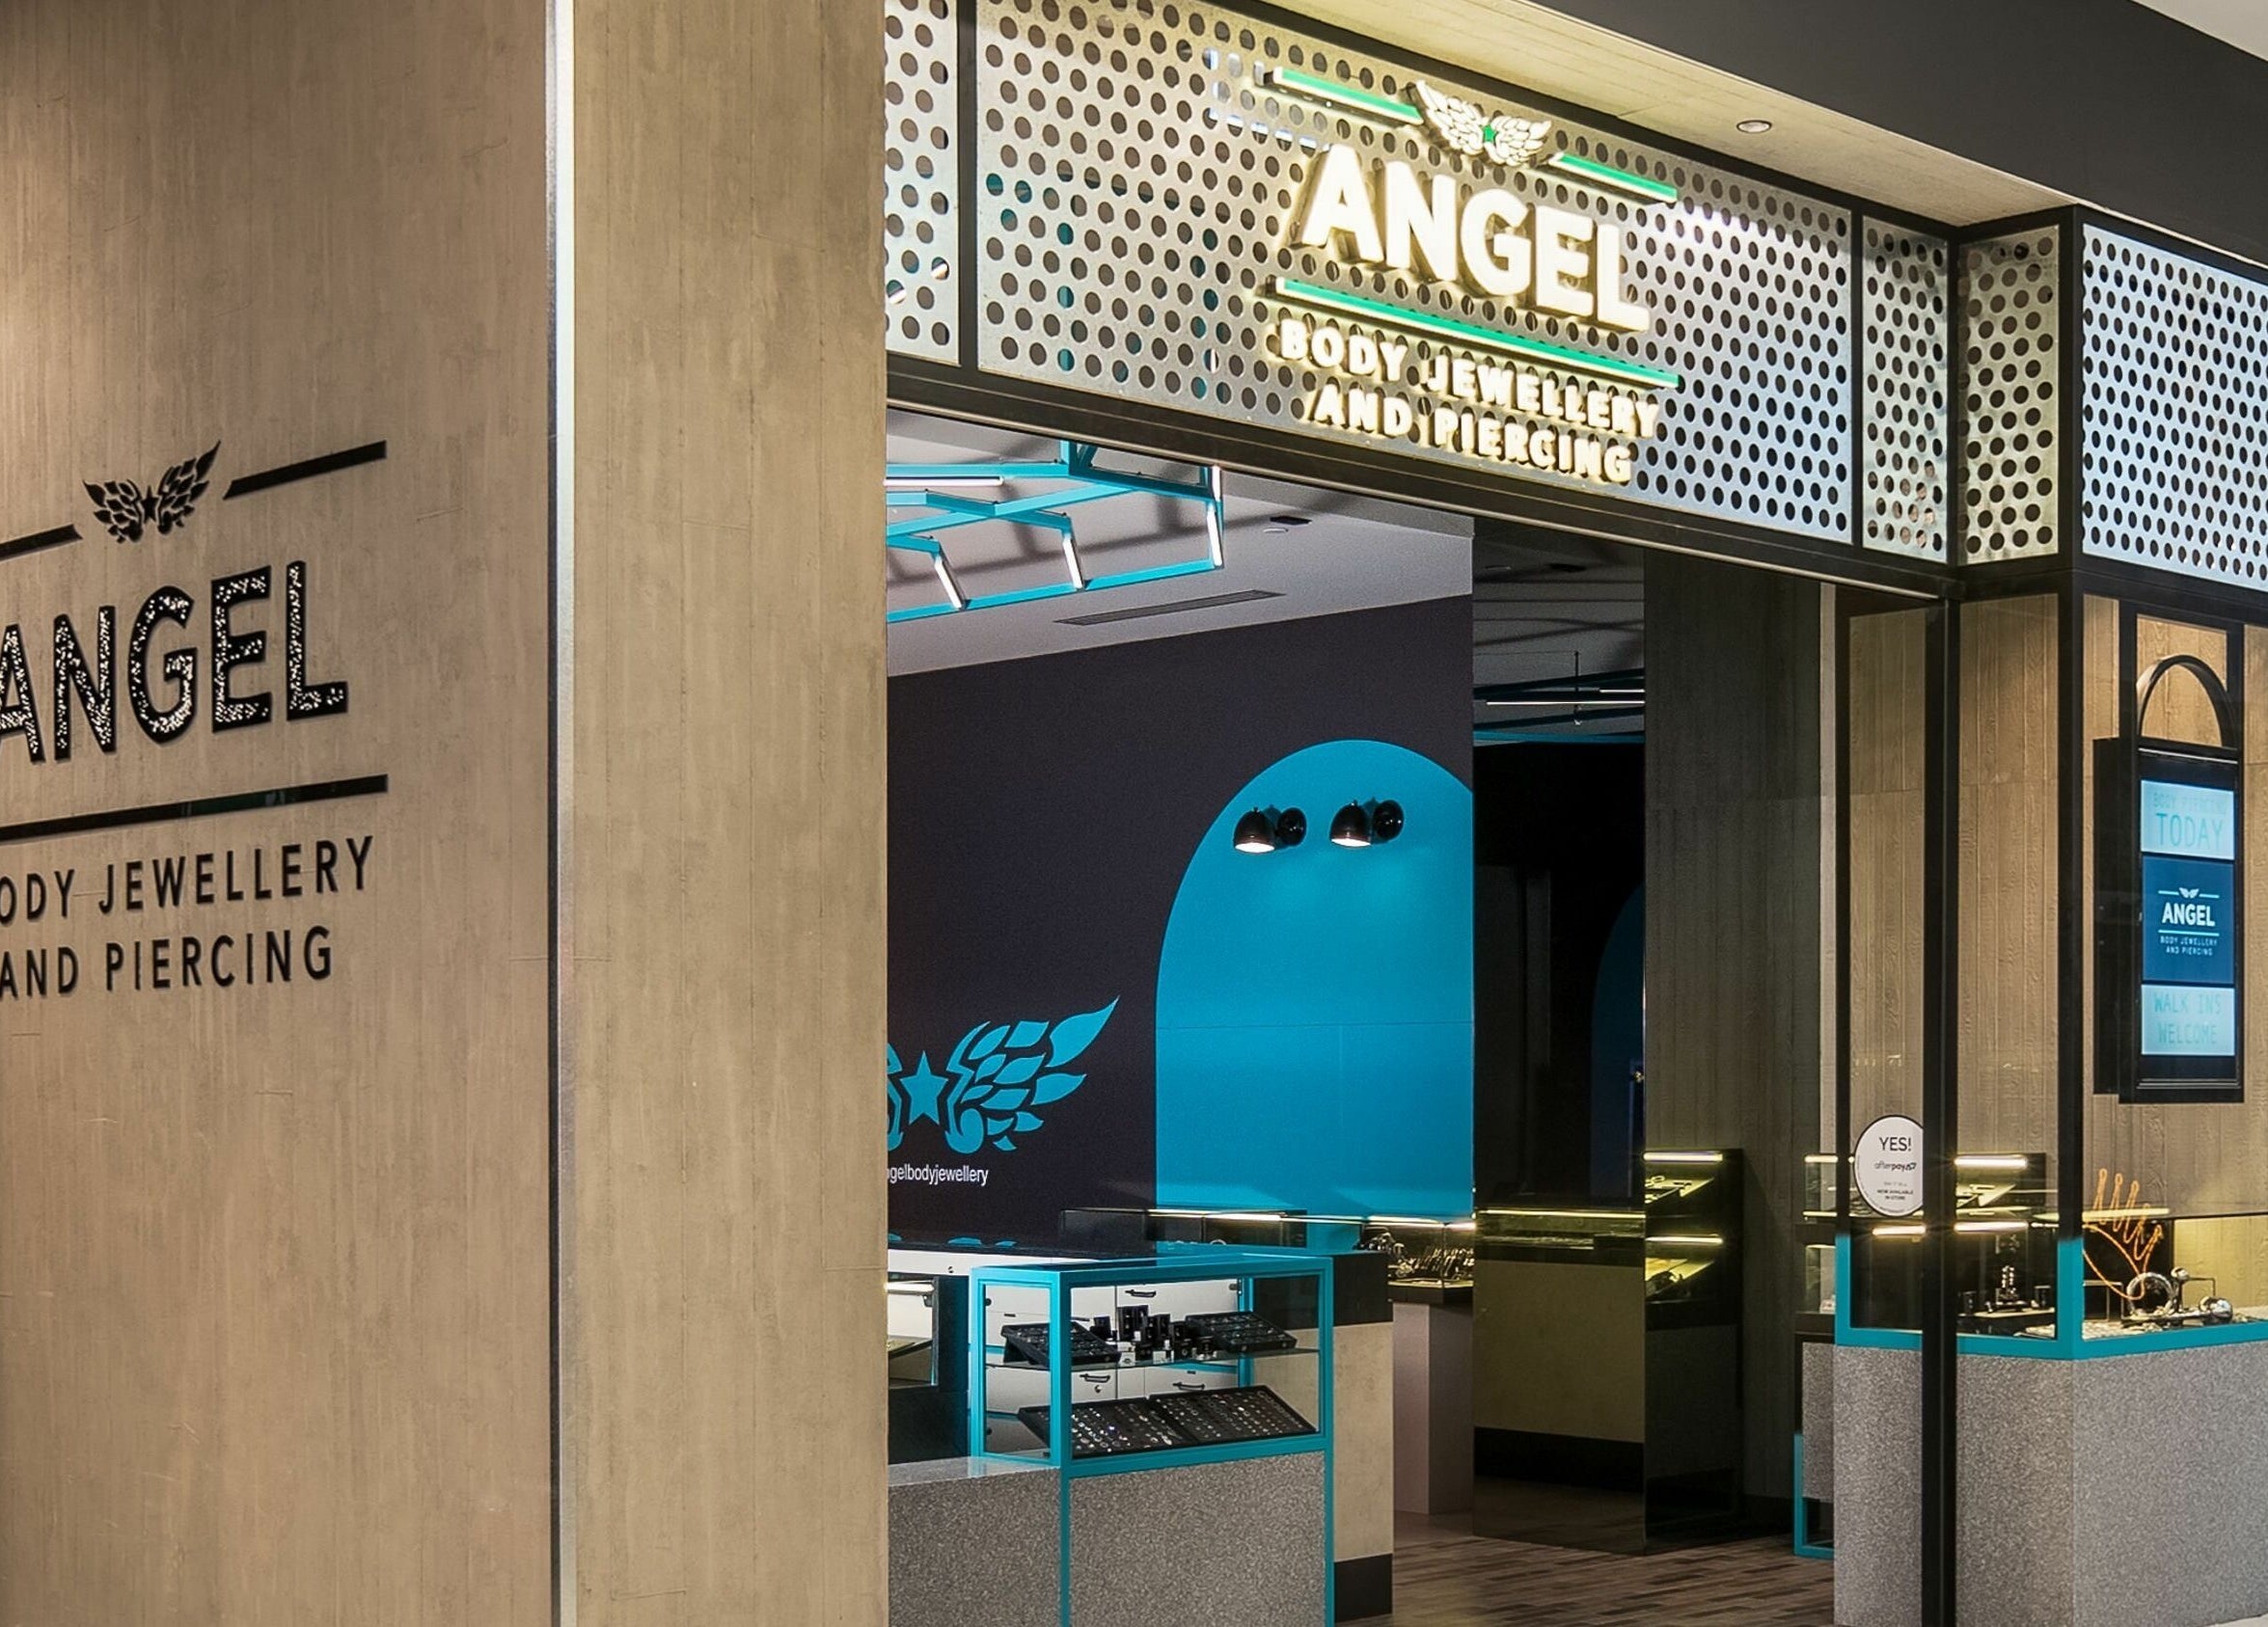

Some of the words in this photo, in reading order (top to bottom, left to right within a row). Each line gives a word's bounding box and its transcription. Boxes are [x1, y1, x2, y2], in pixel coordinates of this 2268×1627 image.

[1297, 144, 1651, 333] ANGEL
[1279, 318, 1408, 382] BODY
[1424, 355, 1659, 439] JEWELLERY
[1312, 384, 1413, 437] AND
[1434, 407, 1632, 483] PIERCING
[0, 559, 349, 763] ANGEL
[2155, 812, 2224, 850] TODAY
[98, 835, 373, 914] JEWELLERY
[2160, 936, 2178, 945] BODY
[2180, 936, 2218, 946] JEWELLERY
[2161, 902, 2216, 927] ANGEL
[2166, 945, 2179, 955] AND
[0, 946, 79, 1001] AND
[106, 925, 332, 991] PIERCING
[1878, 1136, 1912, 1152] YES!
